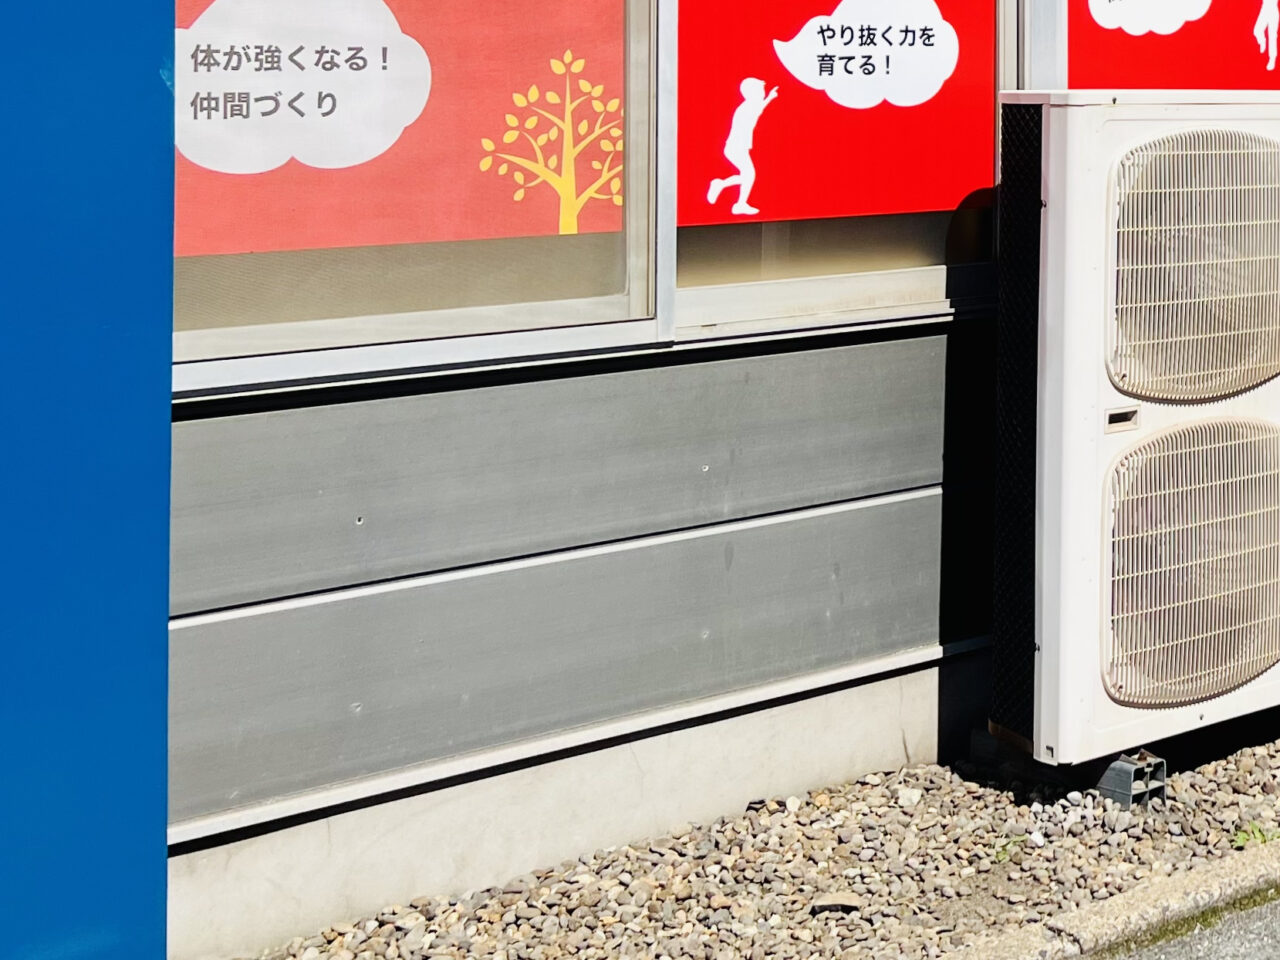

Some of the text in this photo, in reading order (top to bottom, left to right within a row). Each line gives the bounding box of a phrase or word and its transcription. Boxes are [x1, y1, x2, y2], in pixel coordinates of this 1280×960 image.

[816, 23, 936, 47] やり抜く力を
[190, 44, 389, 73] 体が強くなる！
[816, 52, 892, 77] 育てる！
[190, 90, 337, 121] 仲間づくり
